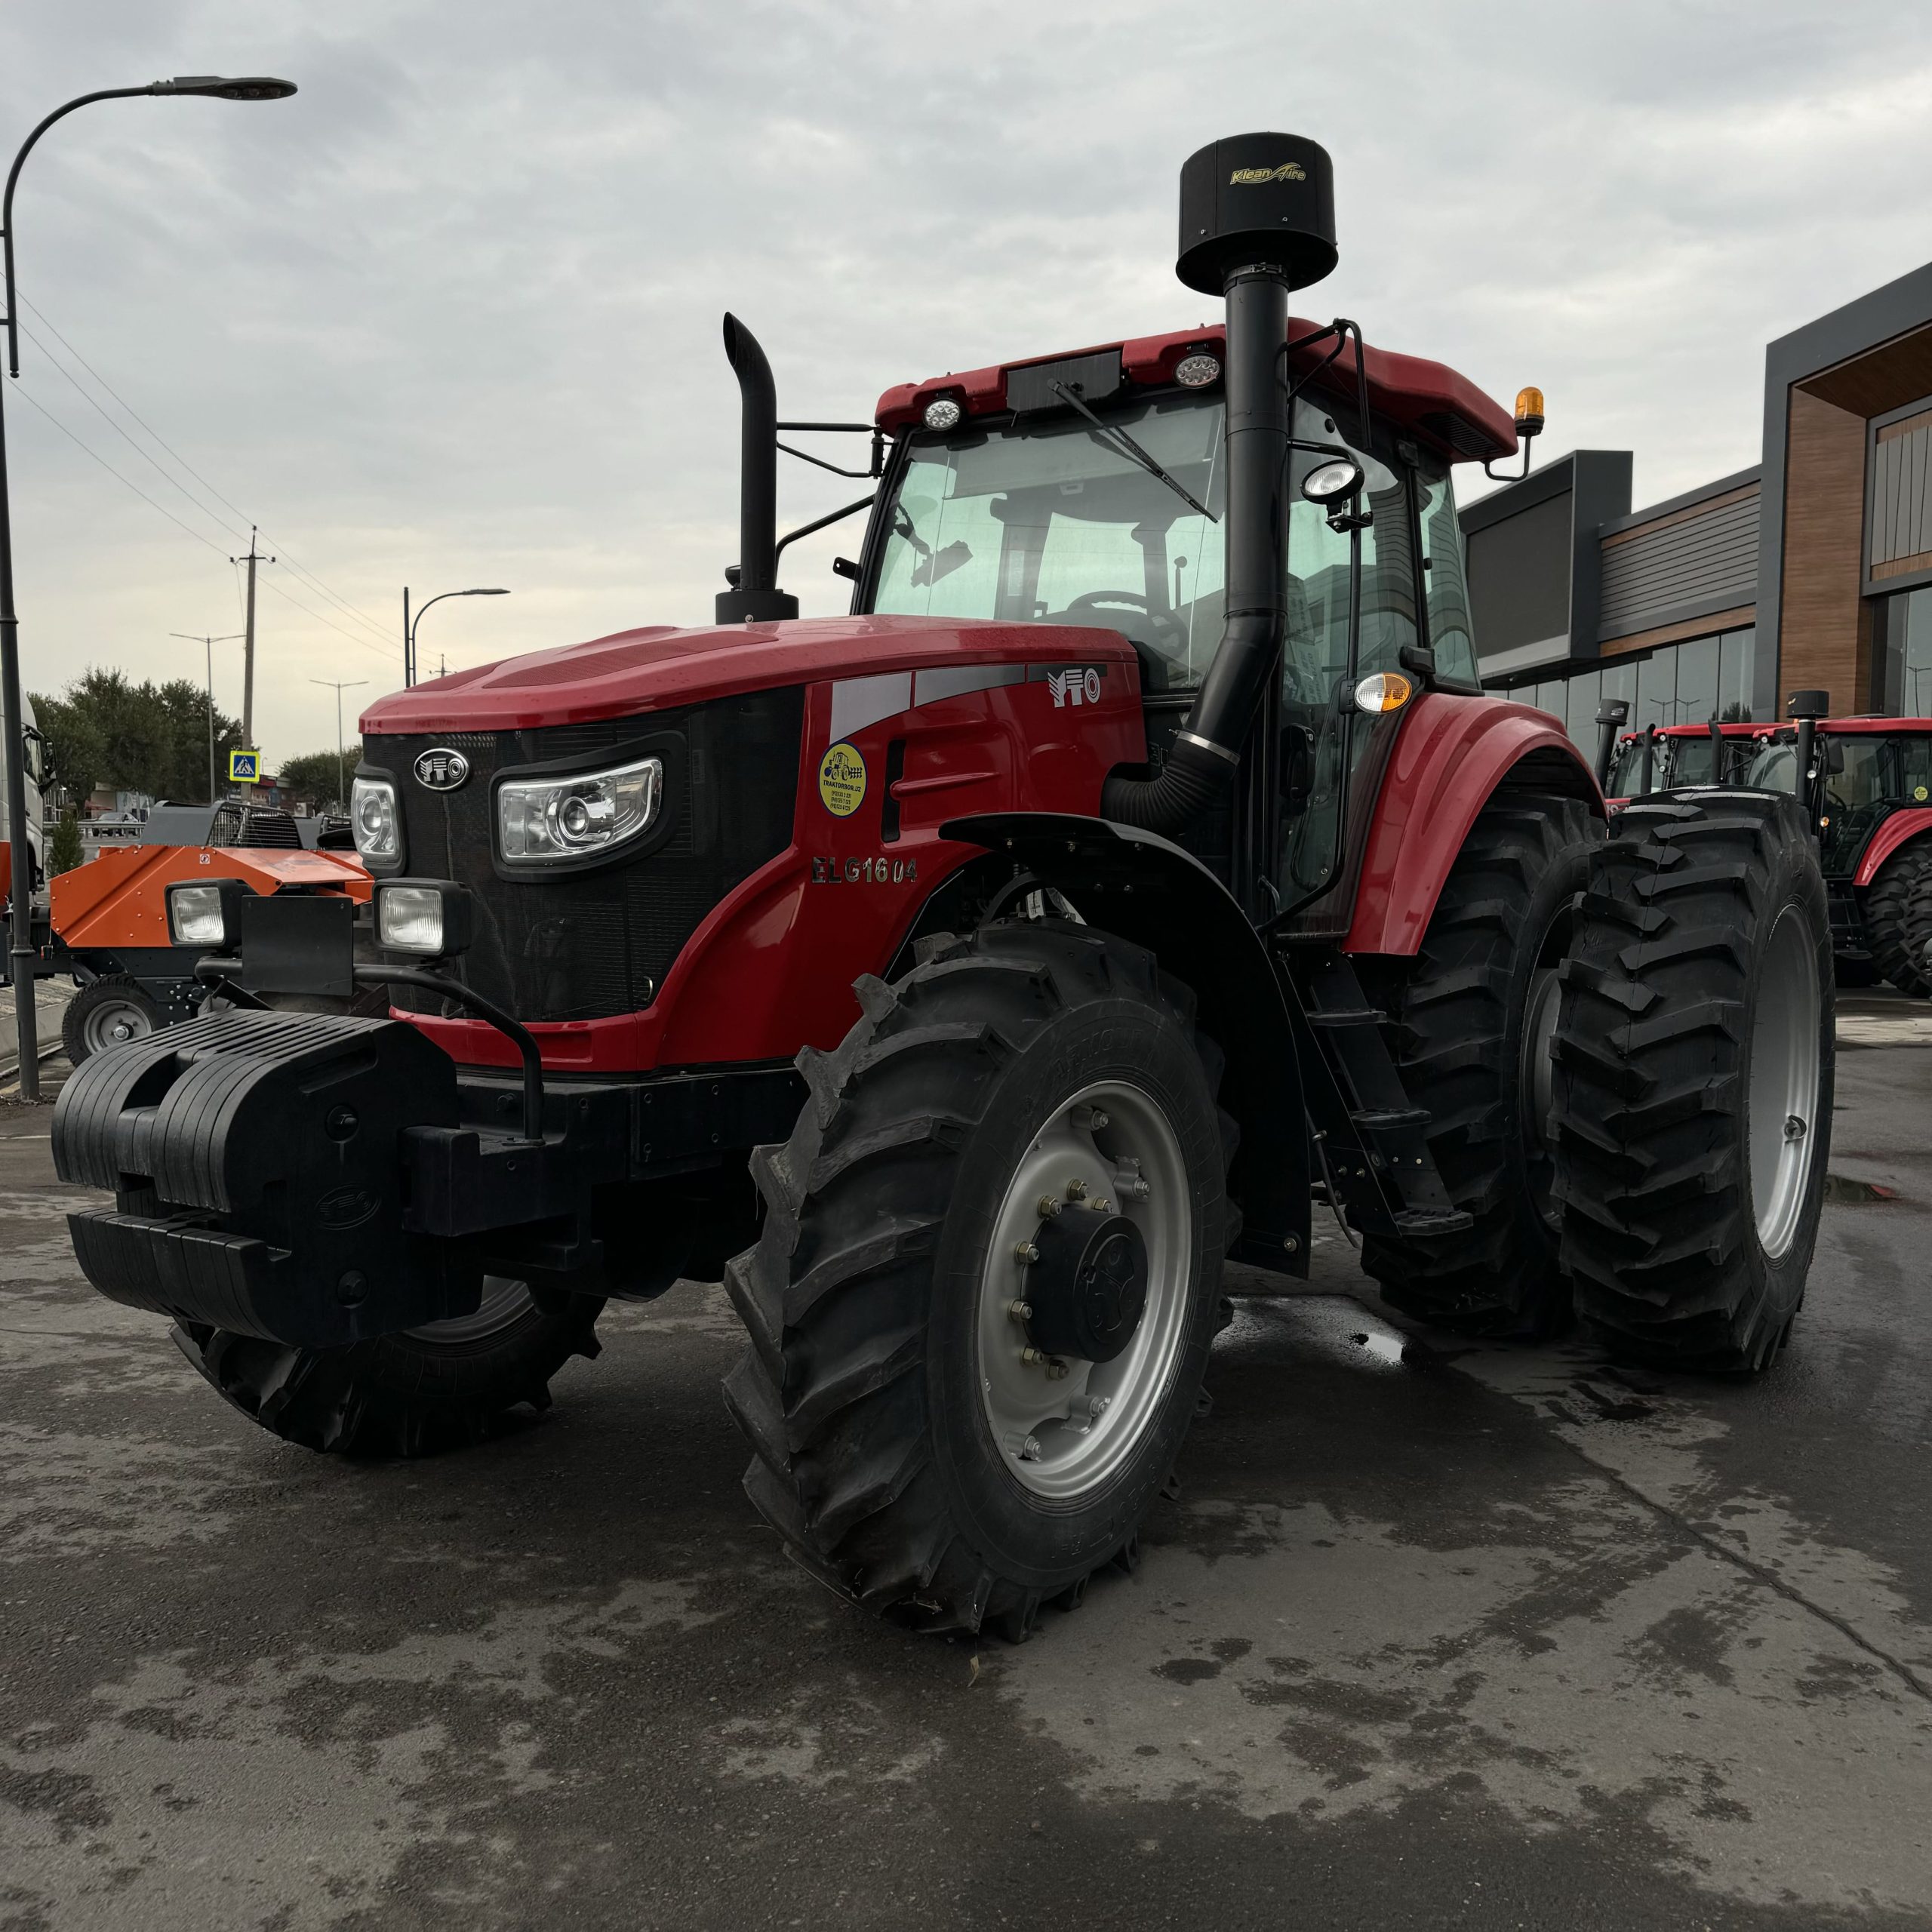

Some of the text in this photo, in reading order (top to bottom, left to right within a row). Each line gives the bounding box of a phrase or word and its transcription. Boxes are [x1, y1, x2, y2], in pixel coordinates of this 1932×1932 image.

[1048, 668, 1101, 708] YTO
[420, 758, 466, 782] YTO
[823, 780, 861, 792] TRAKTORBOR.UZ
[812, 857, 918, 884] ELG1604
